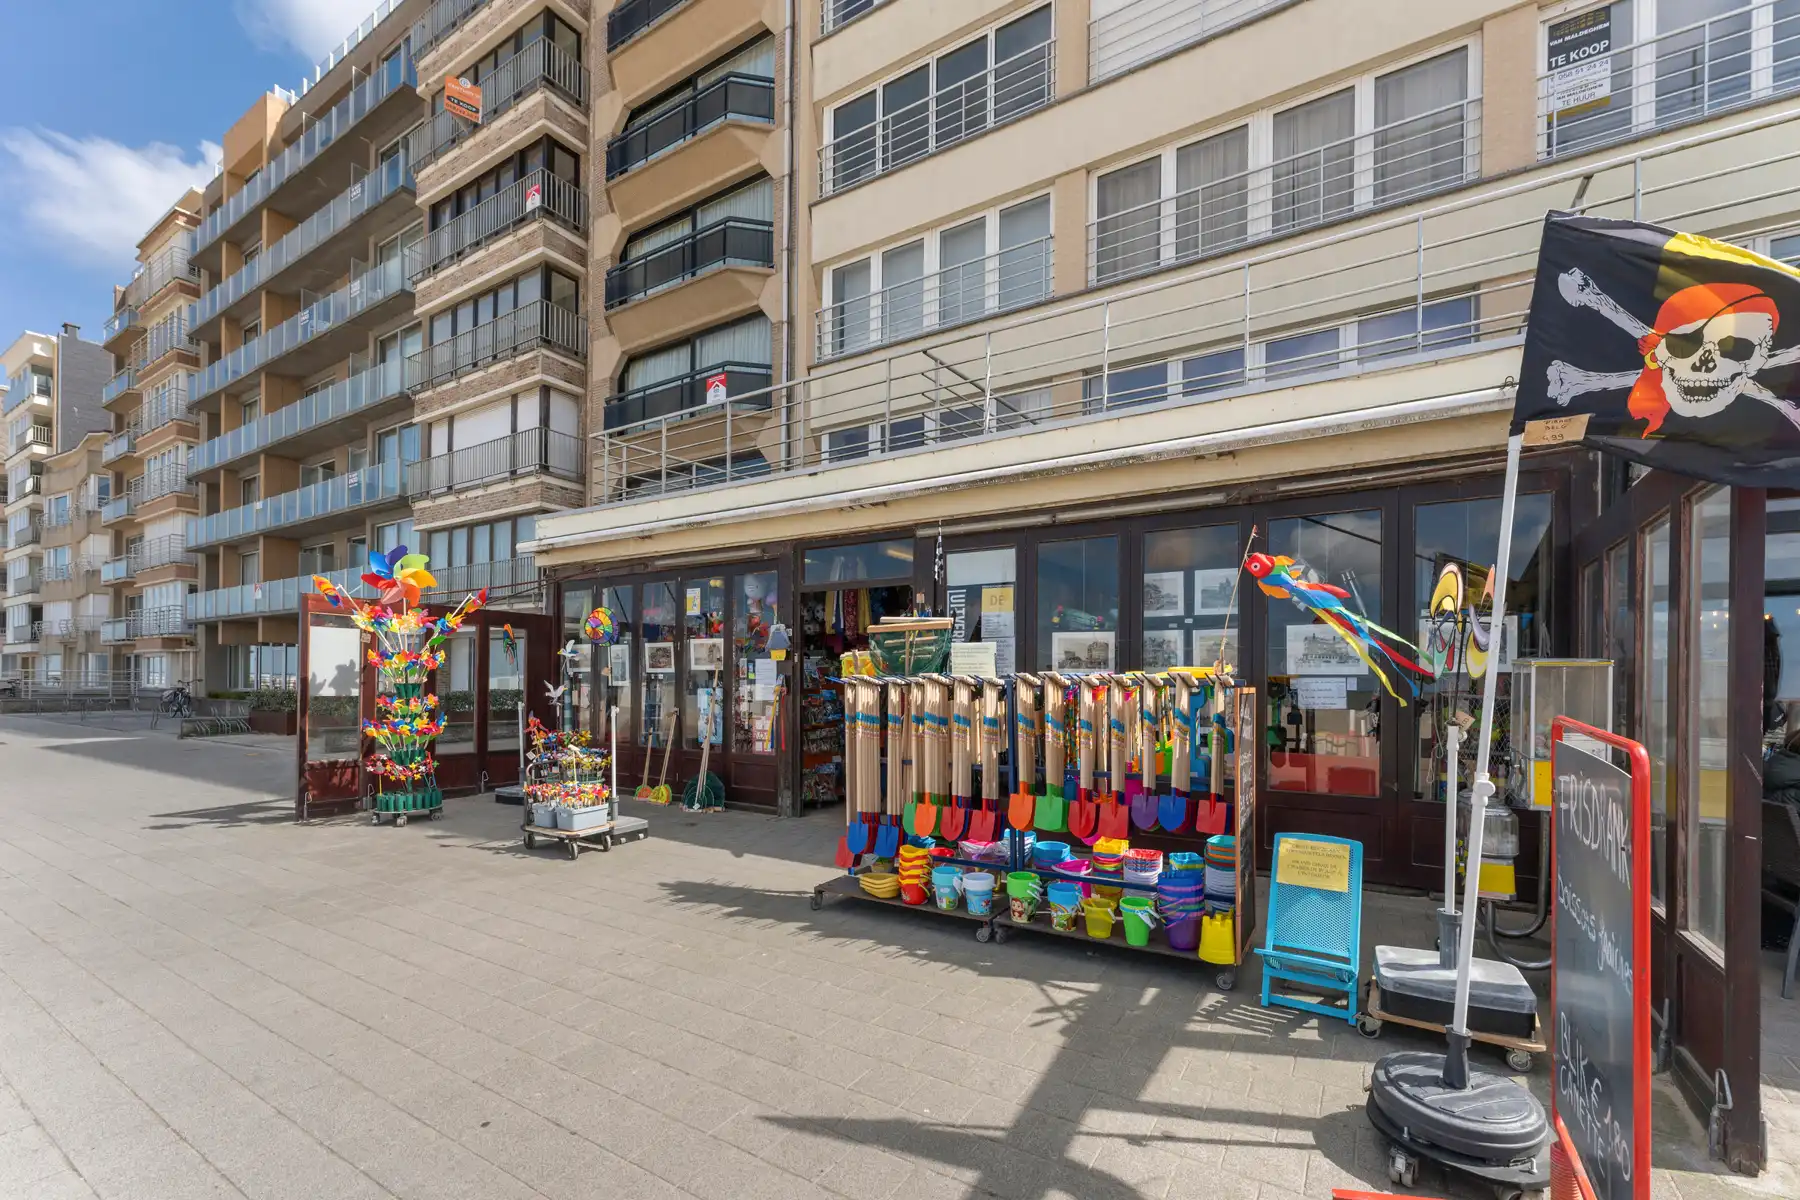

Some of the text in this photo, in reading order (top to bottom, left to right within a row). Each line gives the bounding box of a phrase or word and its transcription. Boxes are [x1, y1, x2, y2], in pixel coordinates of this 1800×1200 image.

[1549, 38, 1563, 47] VAN
[1564, 21, 1610, 42] MALDEGHEM
[1550, 39, 1609, 69] TE KOOP
[1573, 92, 1596, 104] HUUR
[950, 594, 966, 643] UITVER
[1561, 1011, 1589, 1107] BLIK
[1591, 1077, 1602, 1129] €
[1559, 1065, 1606, 1179] CANETTE
